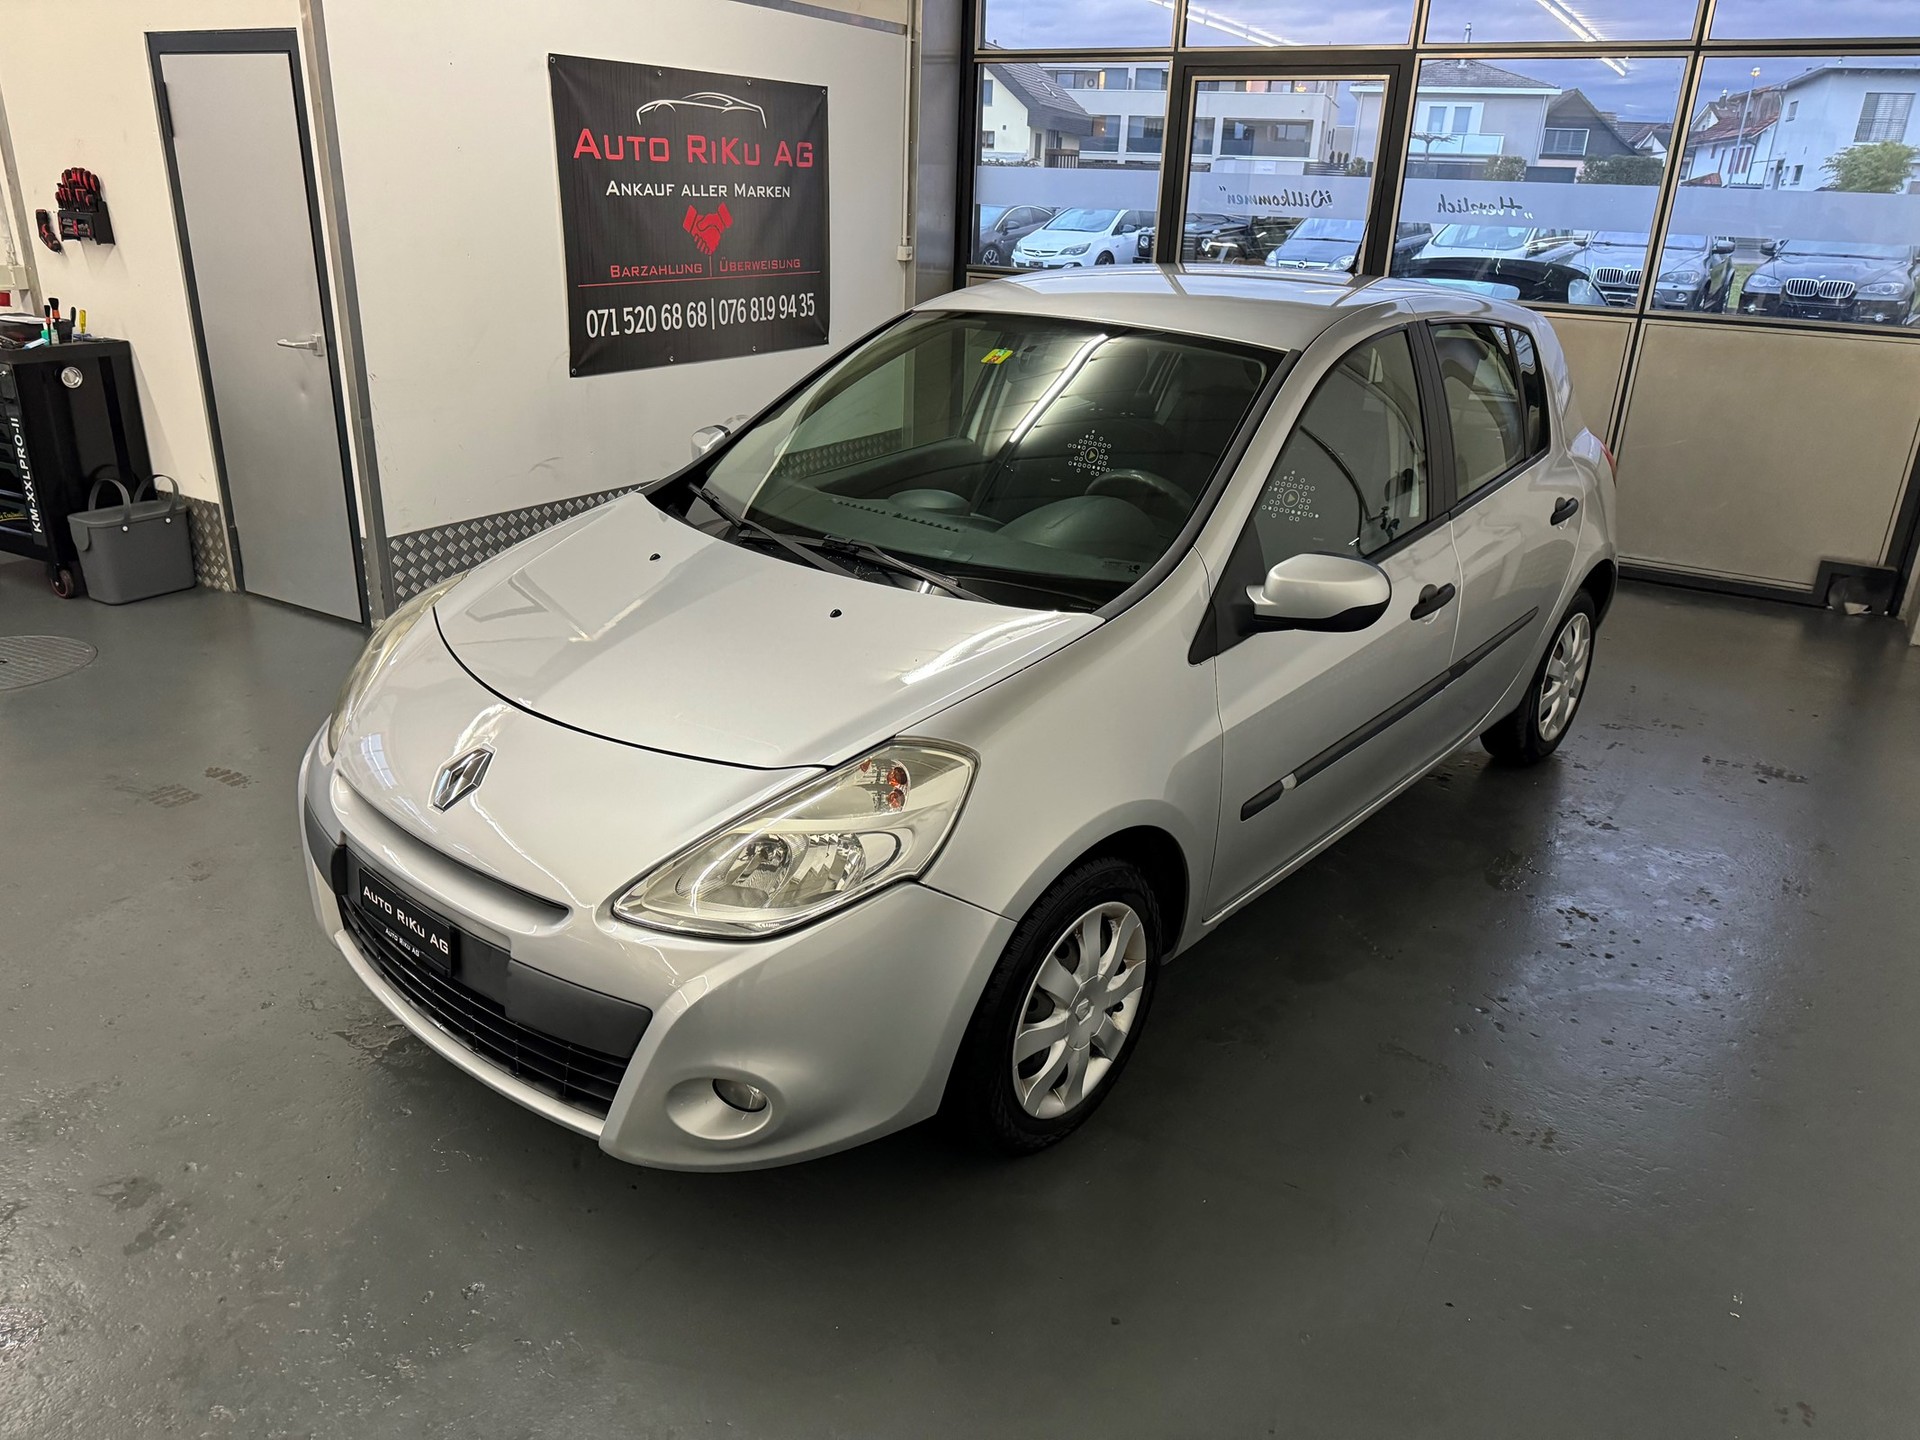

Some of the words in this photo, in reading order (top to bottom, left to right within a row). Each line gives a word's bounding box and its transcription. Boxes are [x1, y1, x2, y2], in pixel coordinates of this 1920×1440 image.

[573, 128, 670, 162] AUTO
[773, 140, 814, 168] AG
[605, 180, 675, 197] ANKAUF
[681, 184, 727, 198] ALLER
[734, 183, 791, 198] MARKEN
[610, 263, 703, 279] BARZAHLUNG
[719, 256, 801, 273] ÜBERWEISUNG
[586, 307, 620, 339] 071
[623, 304, 657, 335] 520
[660, 303, 683, 331] 68
[686, 301, 707, 330] 68
[718, 298, 747, 325] 076
[750, 296, 776, 322] 819
[779, 294, 797, 319] 94
[799, 292, 815, 317] 35
[363, 886, 393, 915] AUTO
[429, 933, 449, 955] AG
[411, 947, 420, 957] AG
